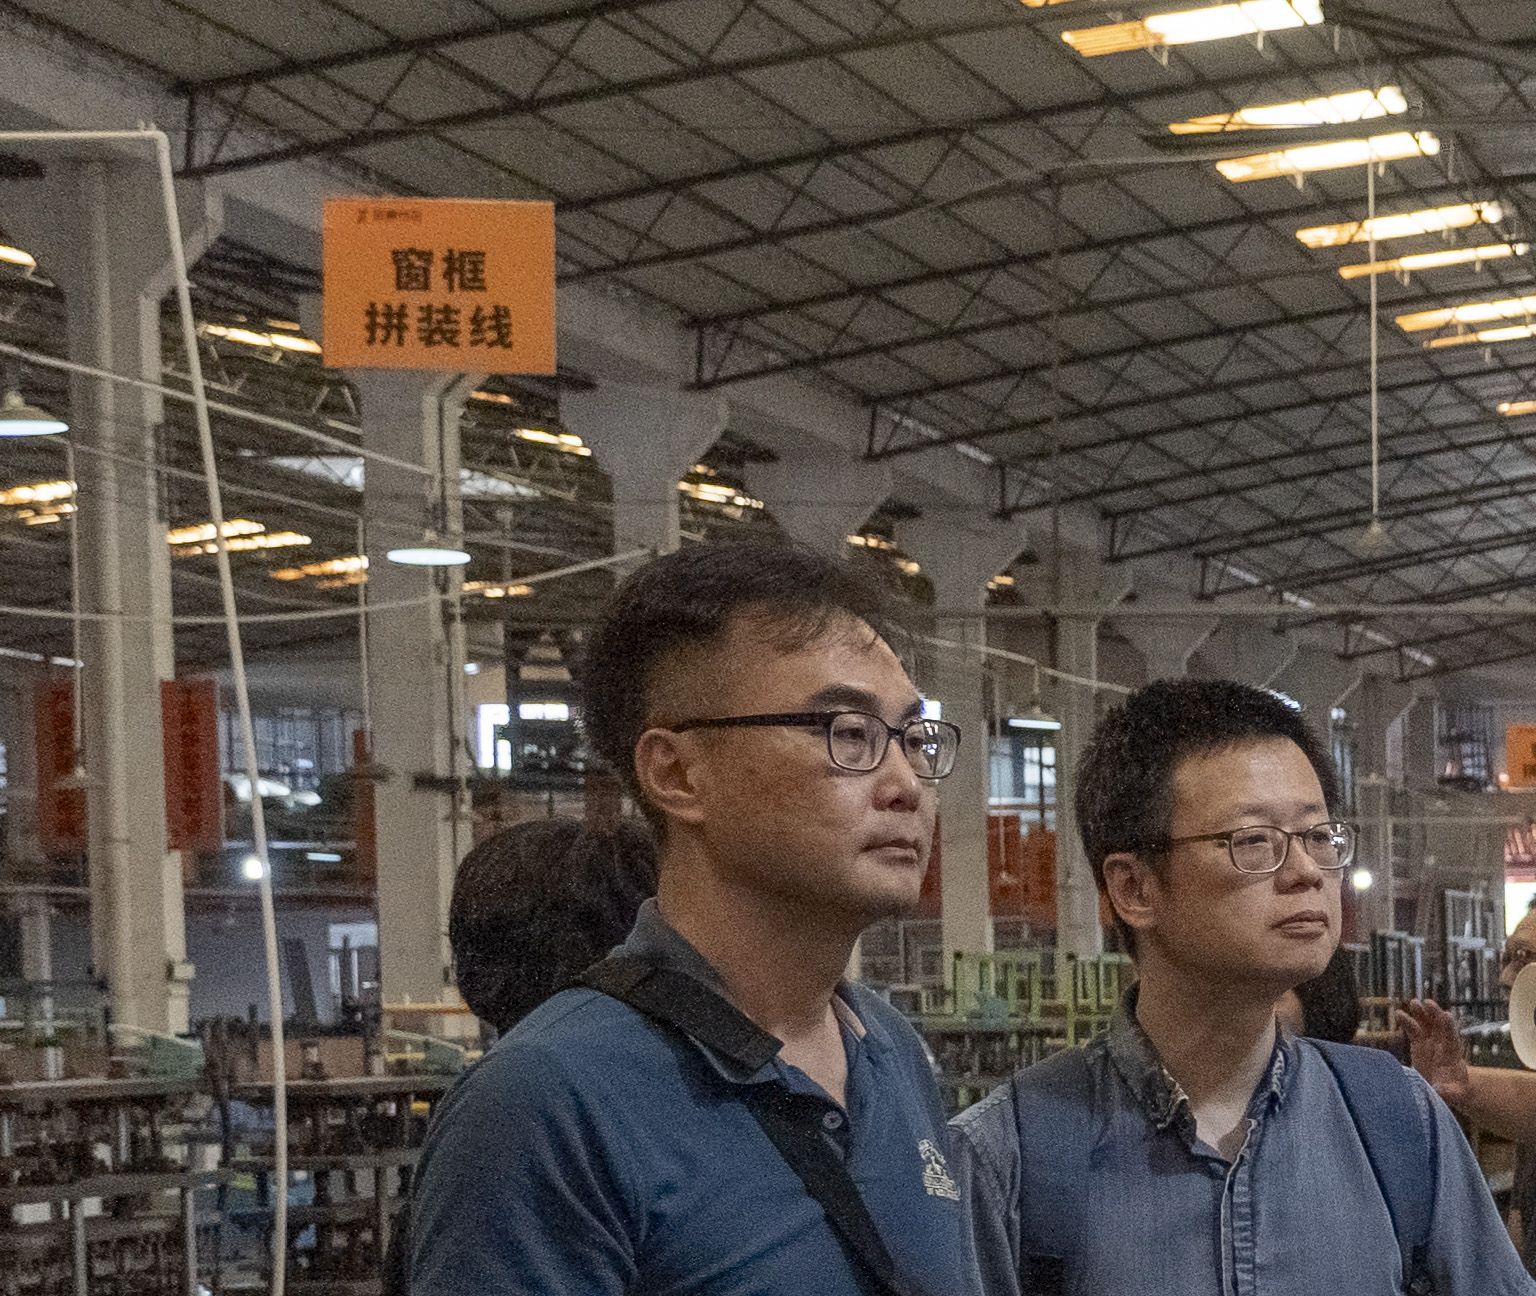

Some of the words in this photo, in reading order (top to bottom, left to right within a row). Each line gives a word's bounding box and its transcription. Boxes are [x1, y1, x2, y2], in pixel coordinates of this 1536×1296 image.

[391, 248, 487, 292] 窗框
[365, 302, 514, 349] 拼装线
